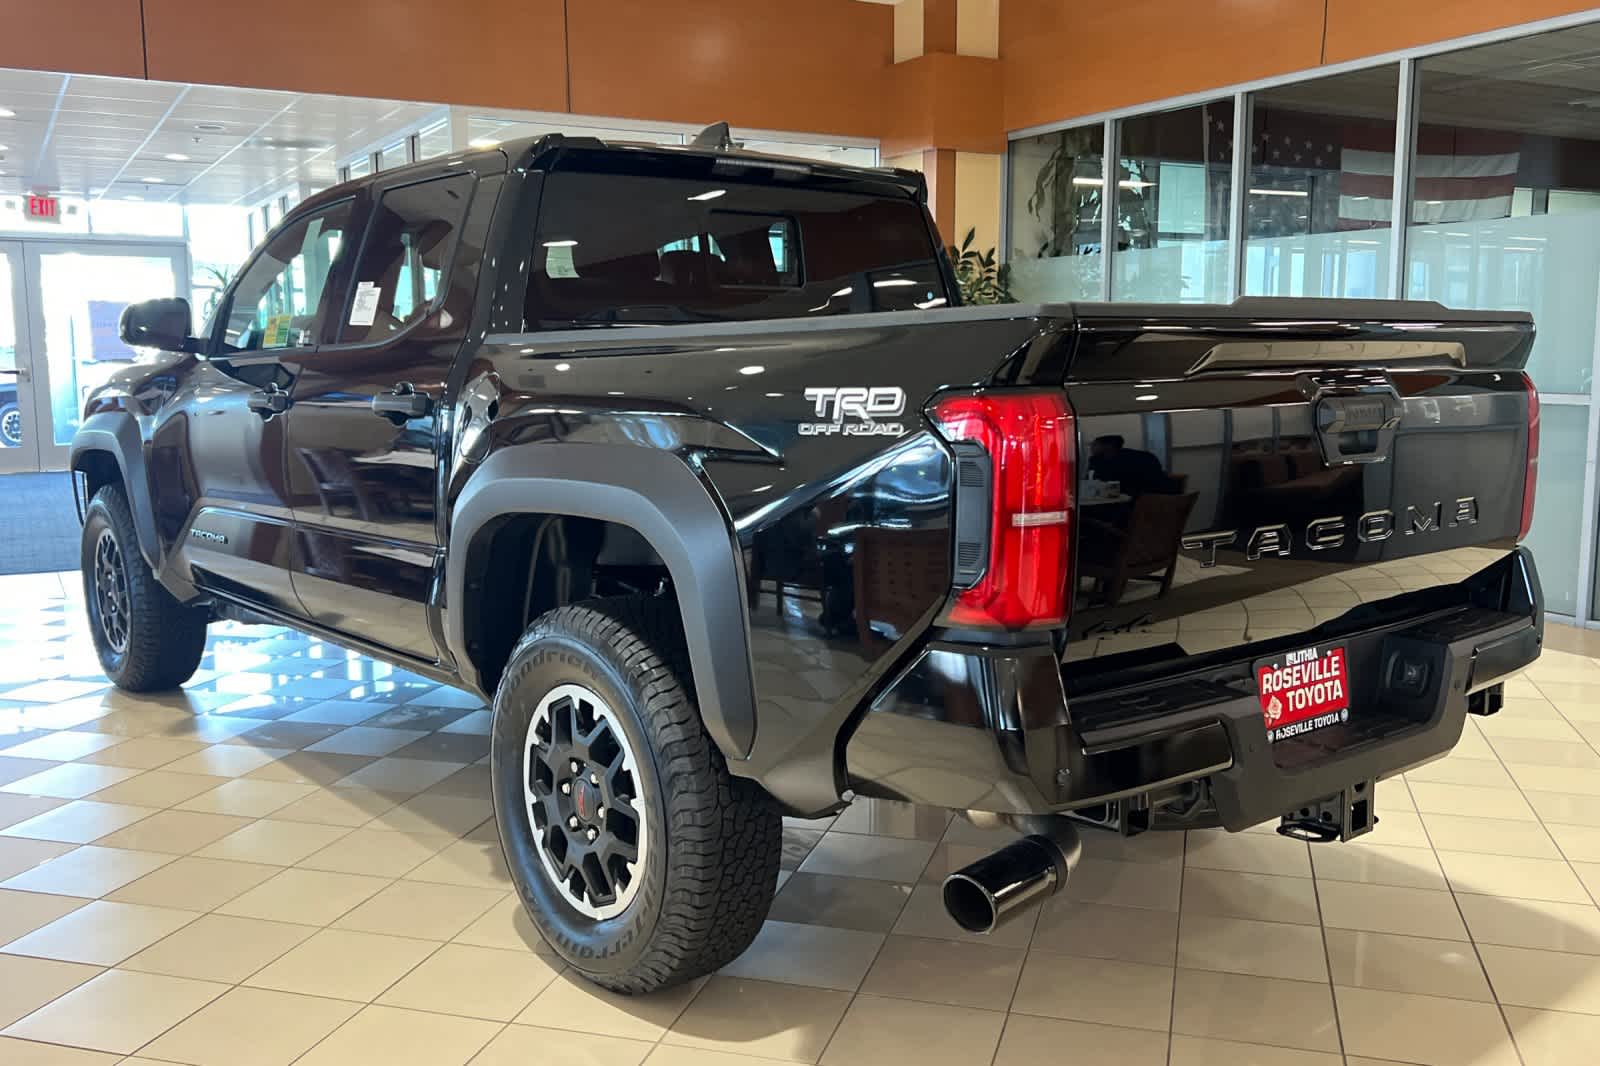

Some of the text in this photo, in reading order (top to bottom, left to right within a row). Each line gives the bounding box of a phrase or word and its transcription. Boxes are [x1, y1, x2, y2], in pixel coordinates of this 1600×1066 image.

[30, 198, 56, 216] EXIT
[804, 386, 907, 424] TRD
[798, 422, 906, 437] OFF ROAD
[190, 528, 225, 543] TACOMA
[1181, 497, 1479, 568] TACOMA
[1293, 648, 1318, 664] LITHIA
[1262, 656, 1340, 694] ROSEVILLE
[1286, 680, 1343, 711] TOYOTA
[1275, 713, 1339, 739] ROSEVILLE TOYOTA
